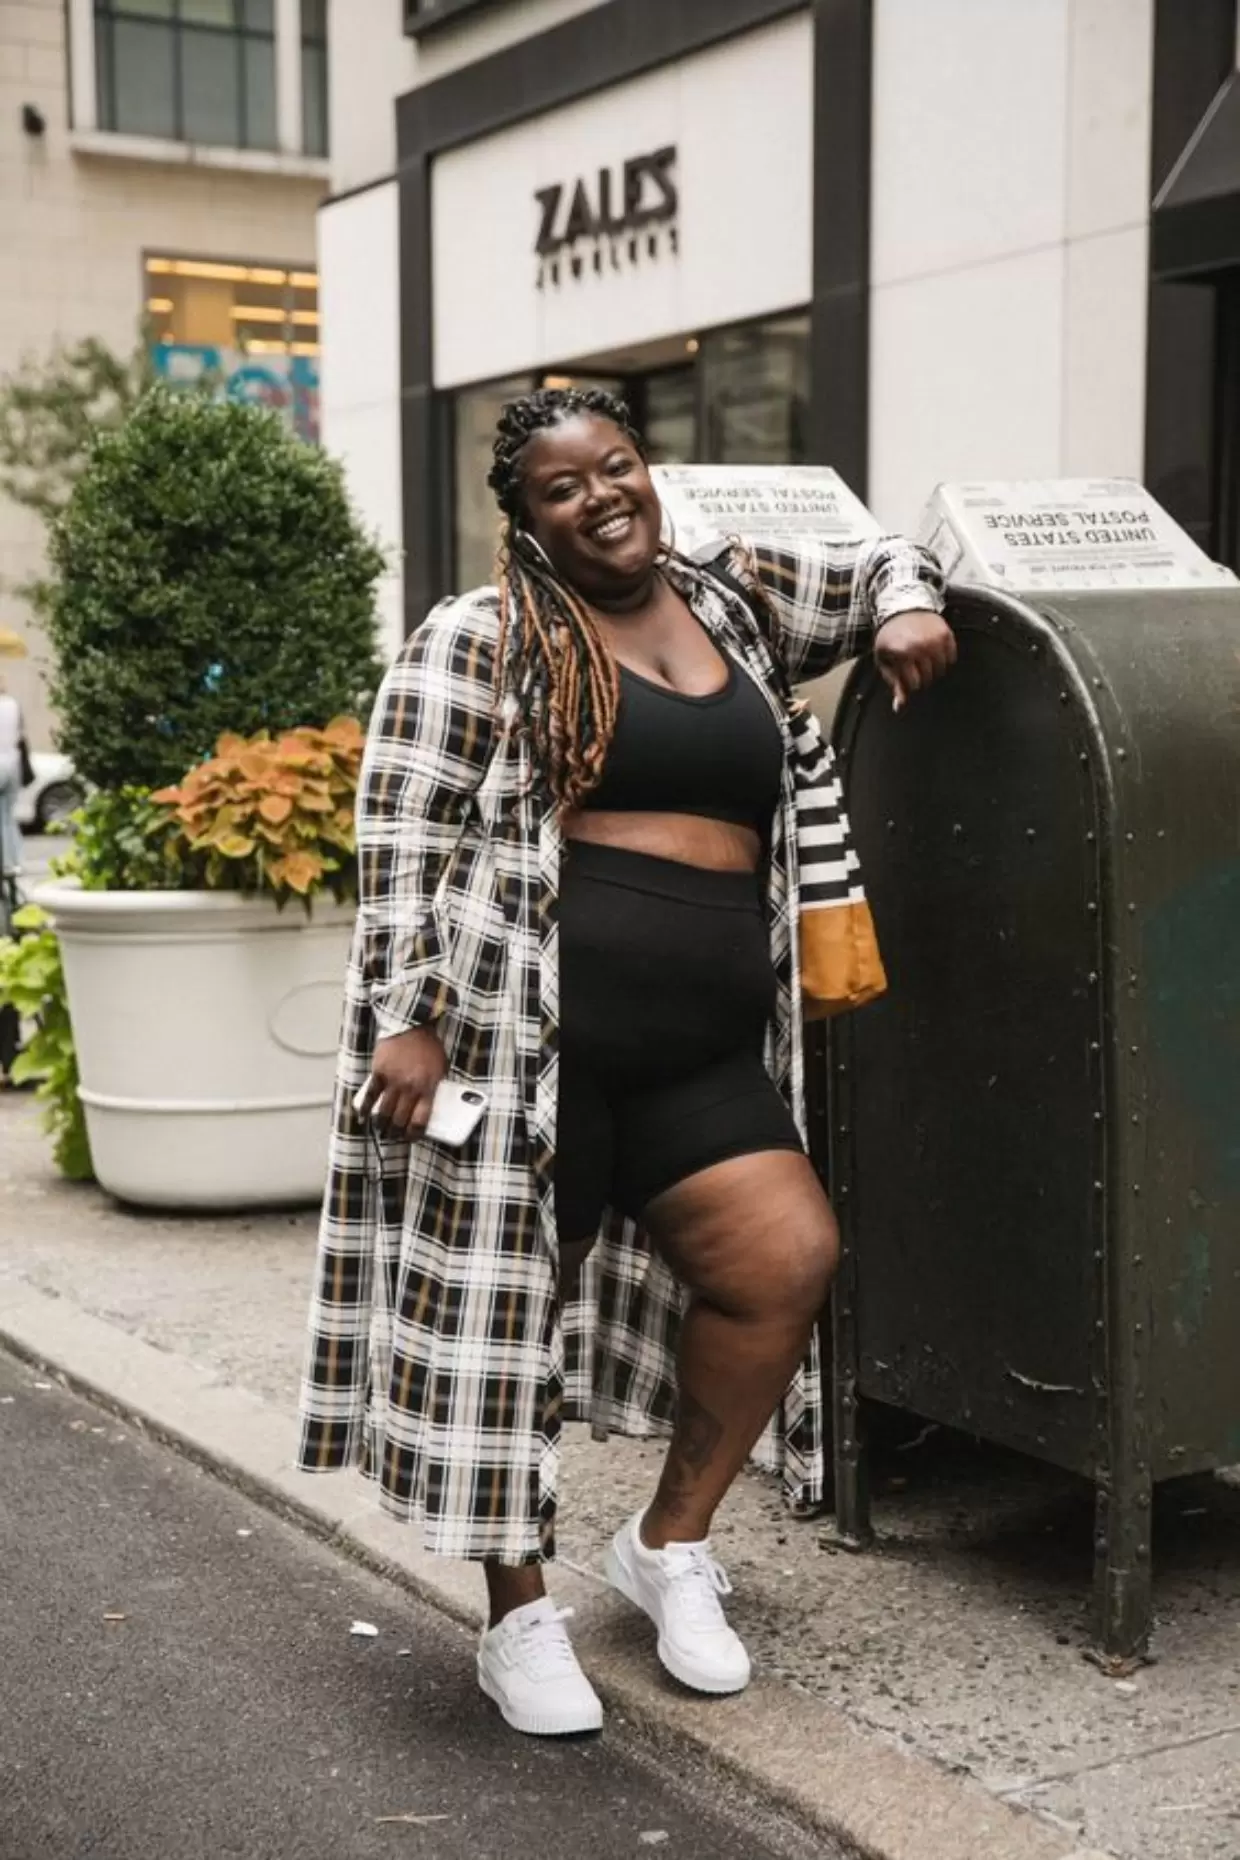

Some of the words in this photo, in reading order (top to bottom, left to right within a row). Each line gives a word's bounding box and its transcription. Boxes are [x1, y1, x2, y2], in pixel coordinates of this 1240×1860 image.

[534, 145, 677, 254] ZALES
[685, 487, 762, 500] SERVICE
[772, 487, 837, 500] POSTAL
[699, 503, 769, 514] STATES
[775, 502, 840, 514] UNITED
[983, 512, 1069, 528] SERVICE
[1071, 510, 1150, 525] POSTAL
[1004, 530, 1081, 546] STATES
[1084, 527, 1157, 544] UNITED
